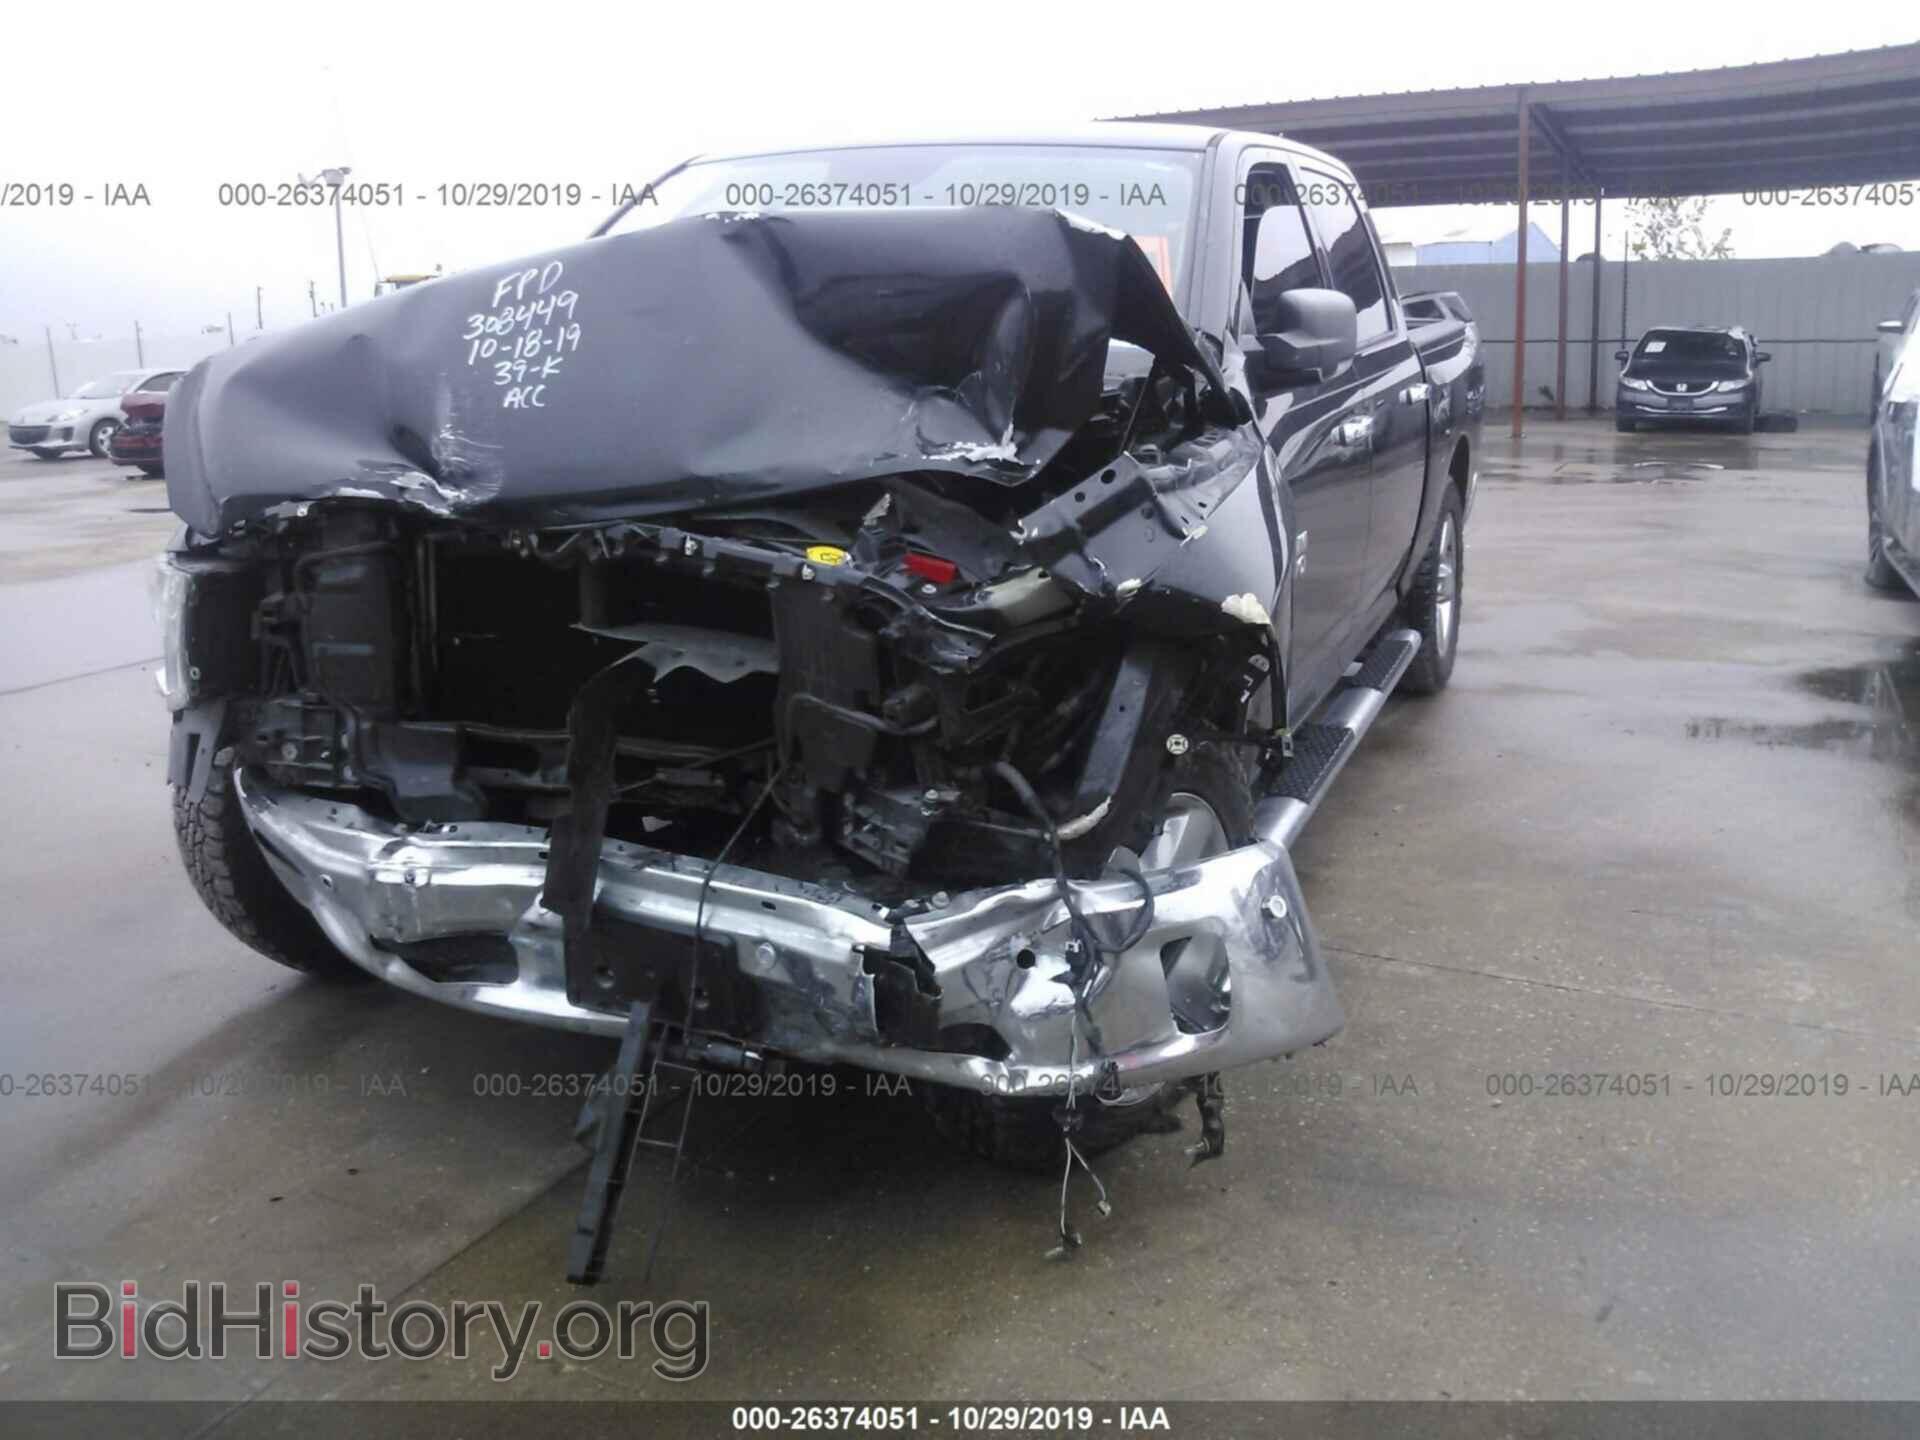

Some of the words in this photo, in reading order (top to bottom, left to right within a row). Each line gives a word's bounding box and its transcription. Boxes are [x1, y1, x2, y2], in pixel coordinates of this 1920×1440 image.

[492, 261, 563, 308] FPD
[463, 290, 579, 340] 308449
[468, 323, 582, 365] 10-18-19
[494, 356, 563, 386] 39-K
[503, 384, 546, 409] ACC
